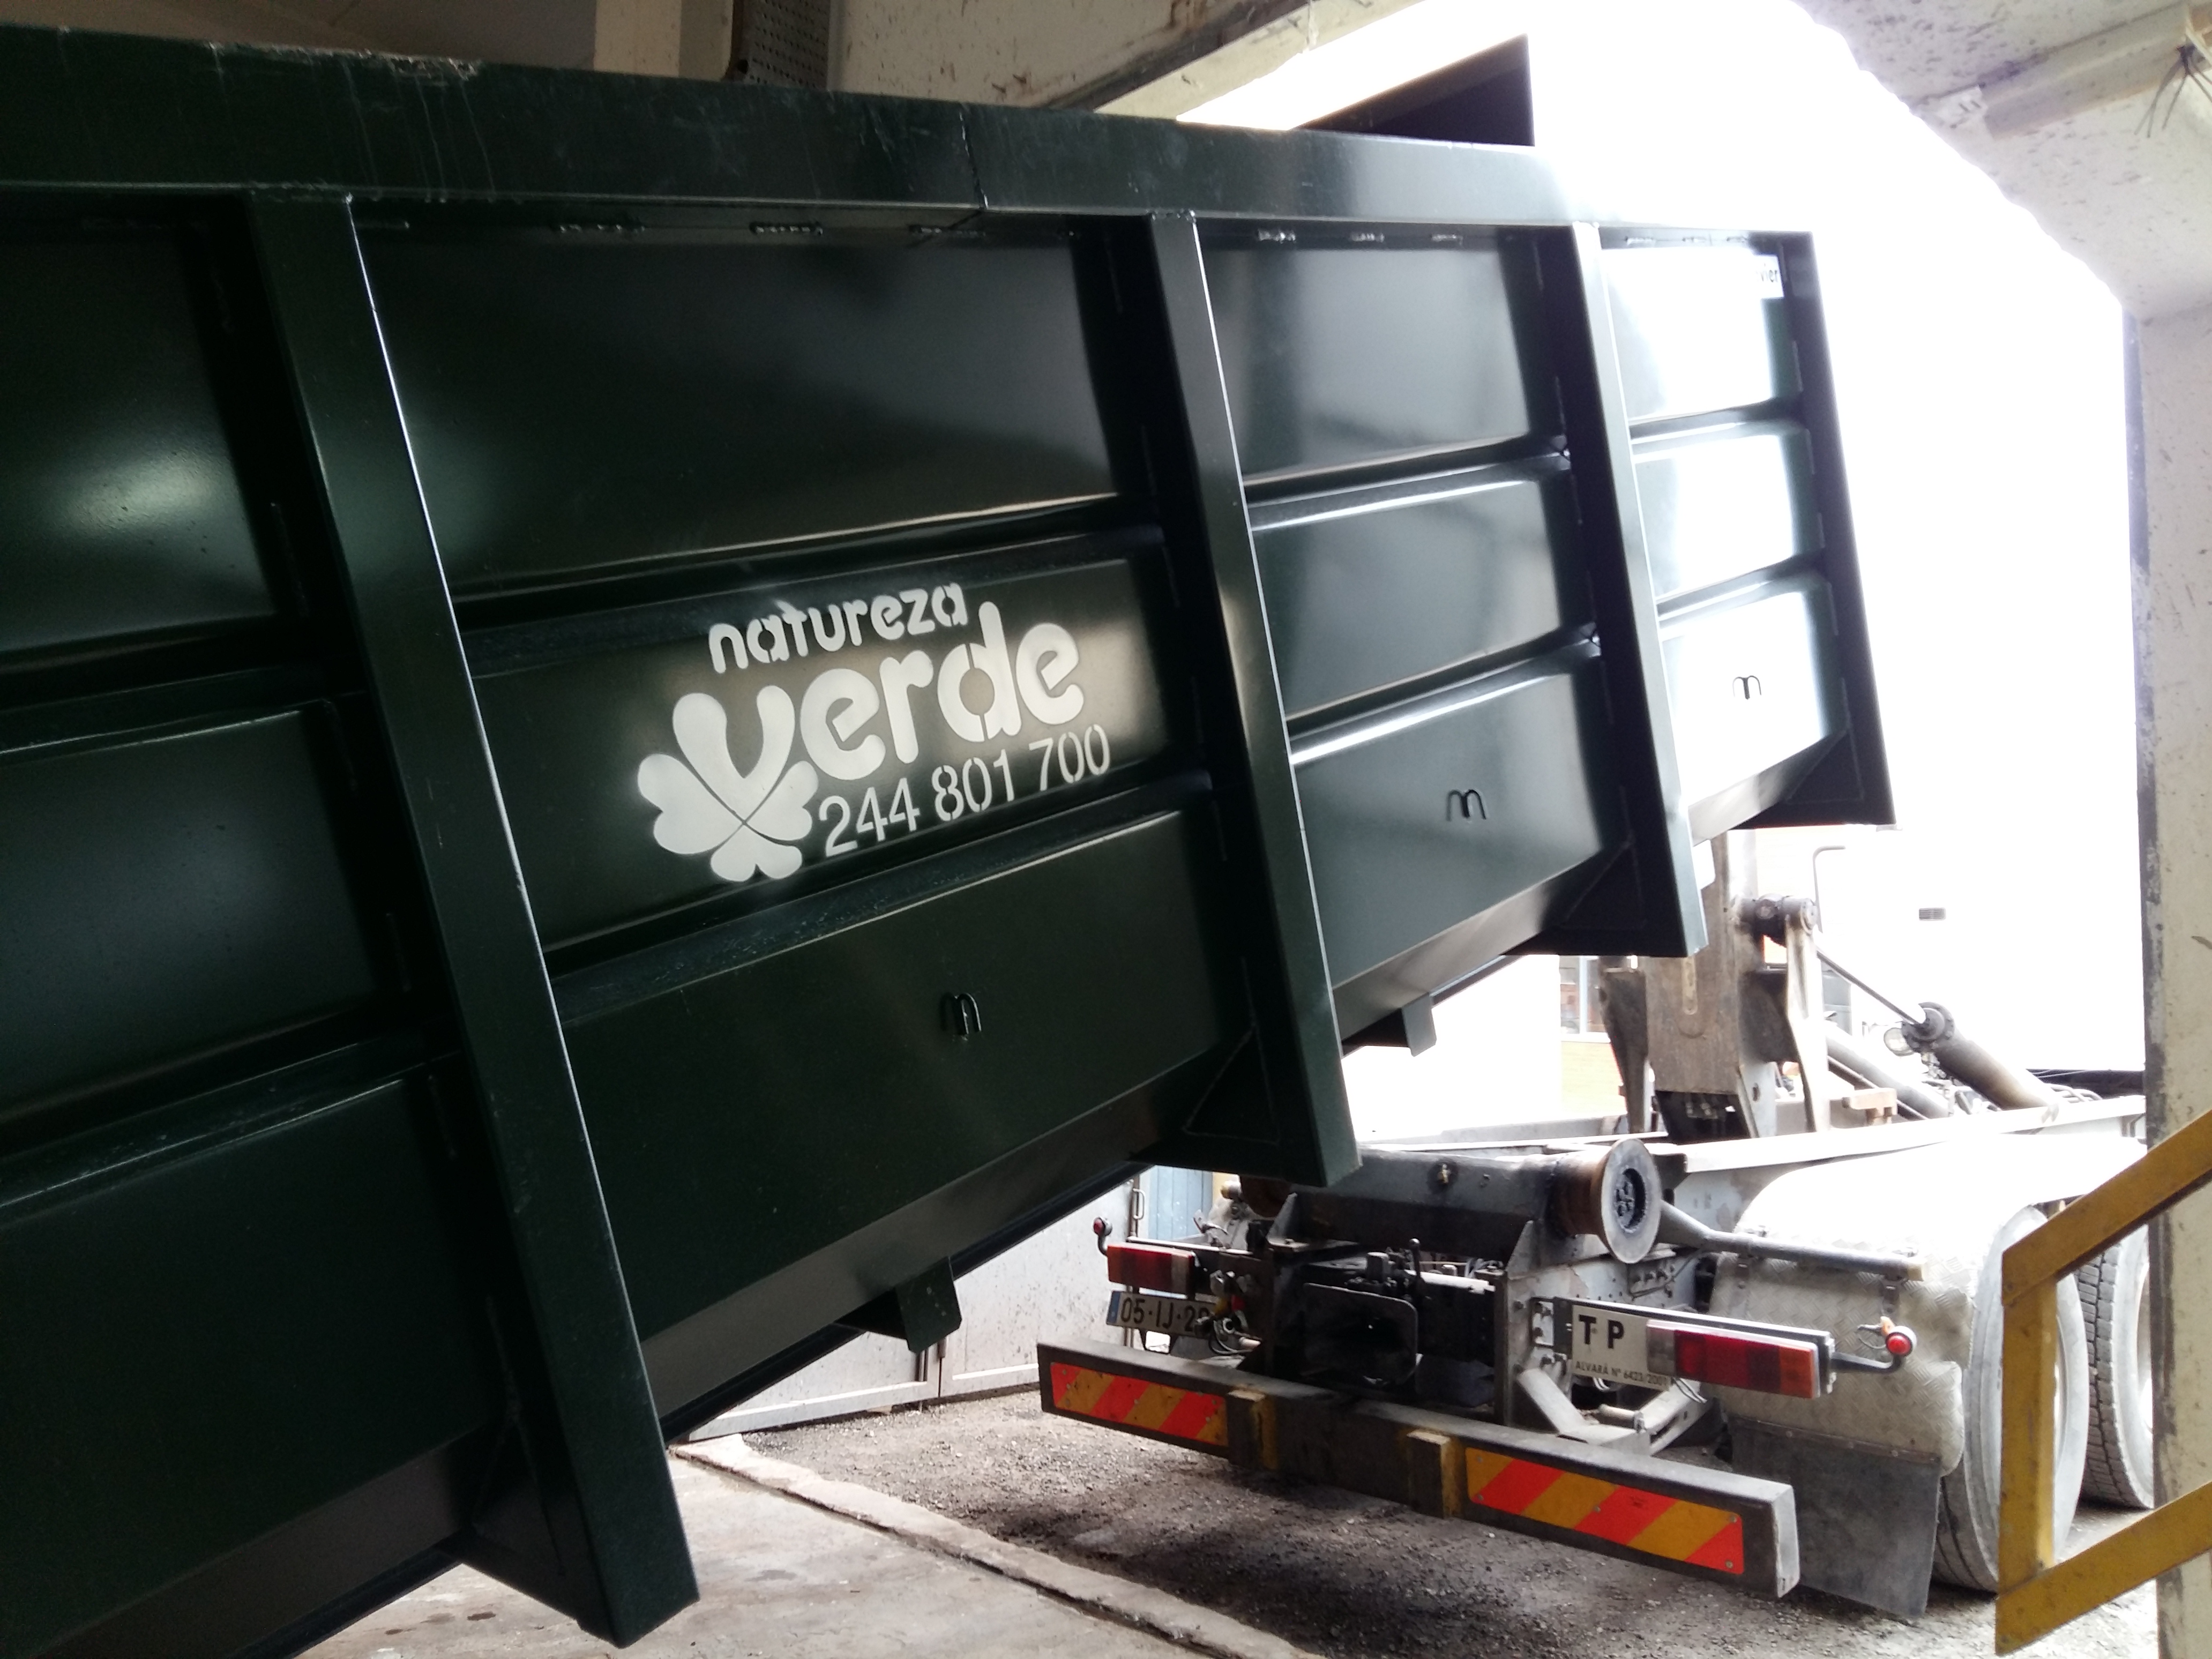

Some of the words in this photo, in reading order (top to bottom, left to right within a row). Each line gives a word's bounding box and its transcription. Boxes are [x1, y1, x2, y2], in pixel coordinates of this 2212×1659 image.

[708, 582, 969, 674] natureza
[672, 601, 1084, 820] verde
[818, 777, 920, 857] 244
[931, 750, 1014, 821] 801
[1029, 724, 1111, 791] 700
[1575, 1361, 1609, 1375] ALVARÁ
